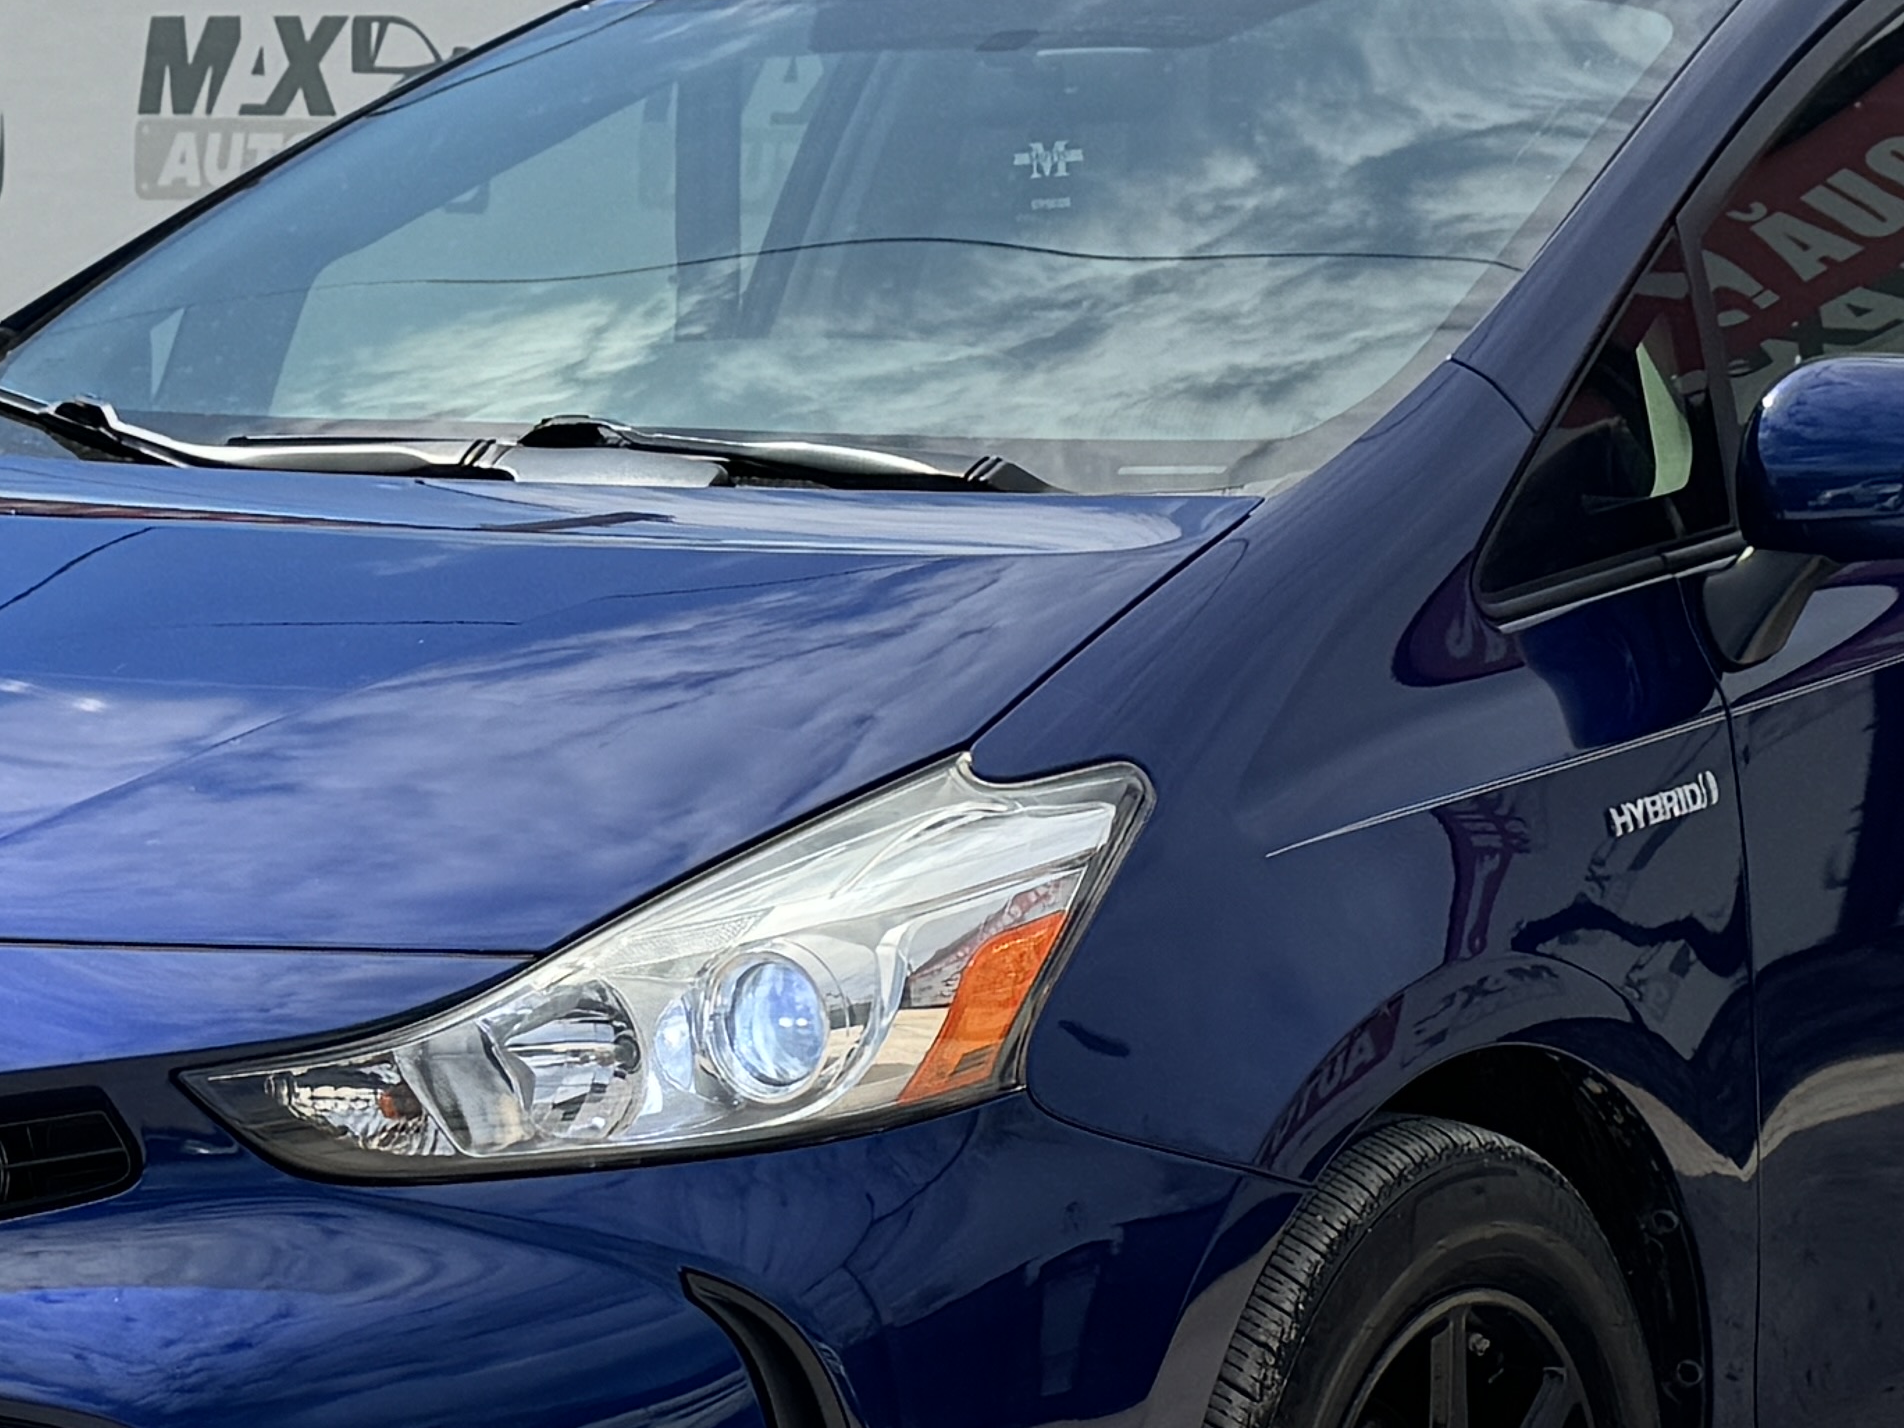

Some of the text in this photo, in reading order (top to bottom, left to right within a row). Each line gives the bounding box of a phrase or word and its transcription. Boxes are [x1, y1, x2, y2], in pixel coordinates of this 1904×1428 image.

[137, 14, 350, 117] MAX
[157, 131, 310, 187] AUT
[1608, 778, 1708, 838] HYBRID
